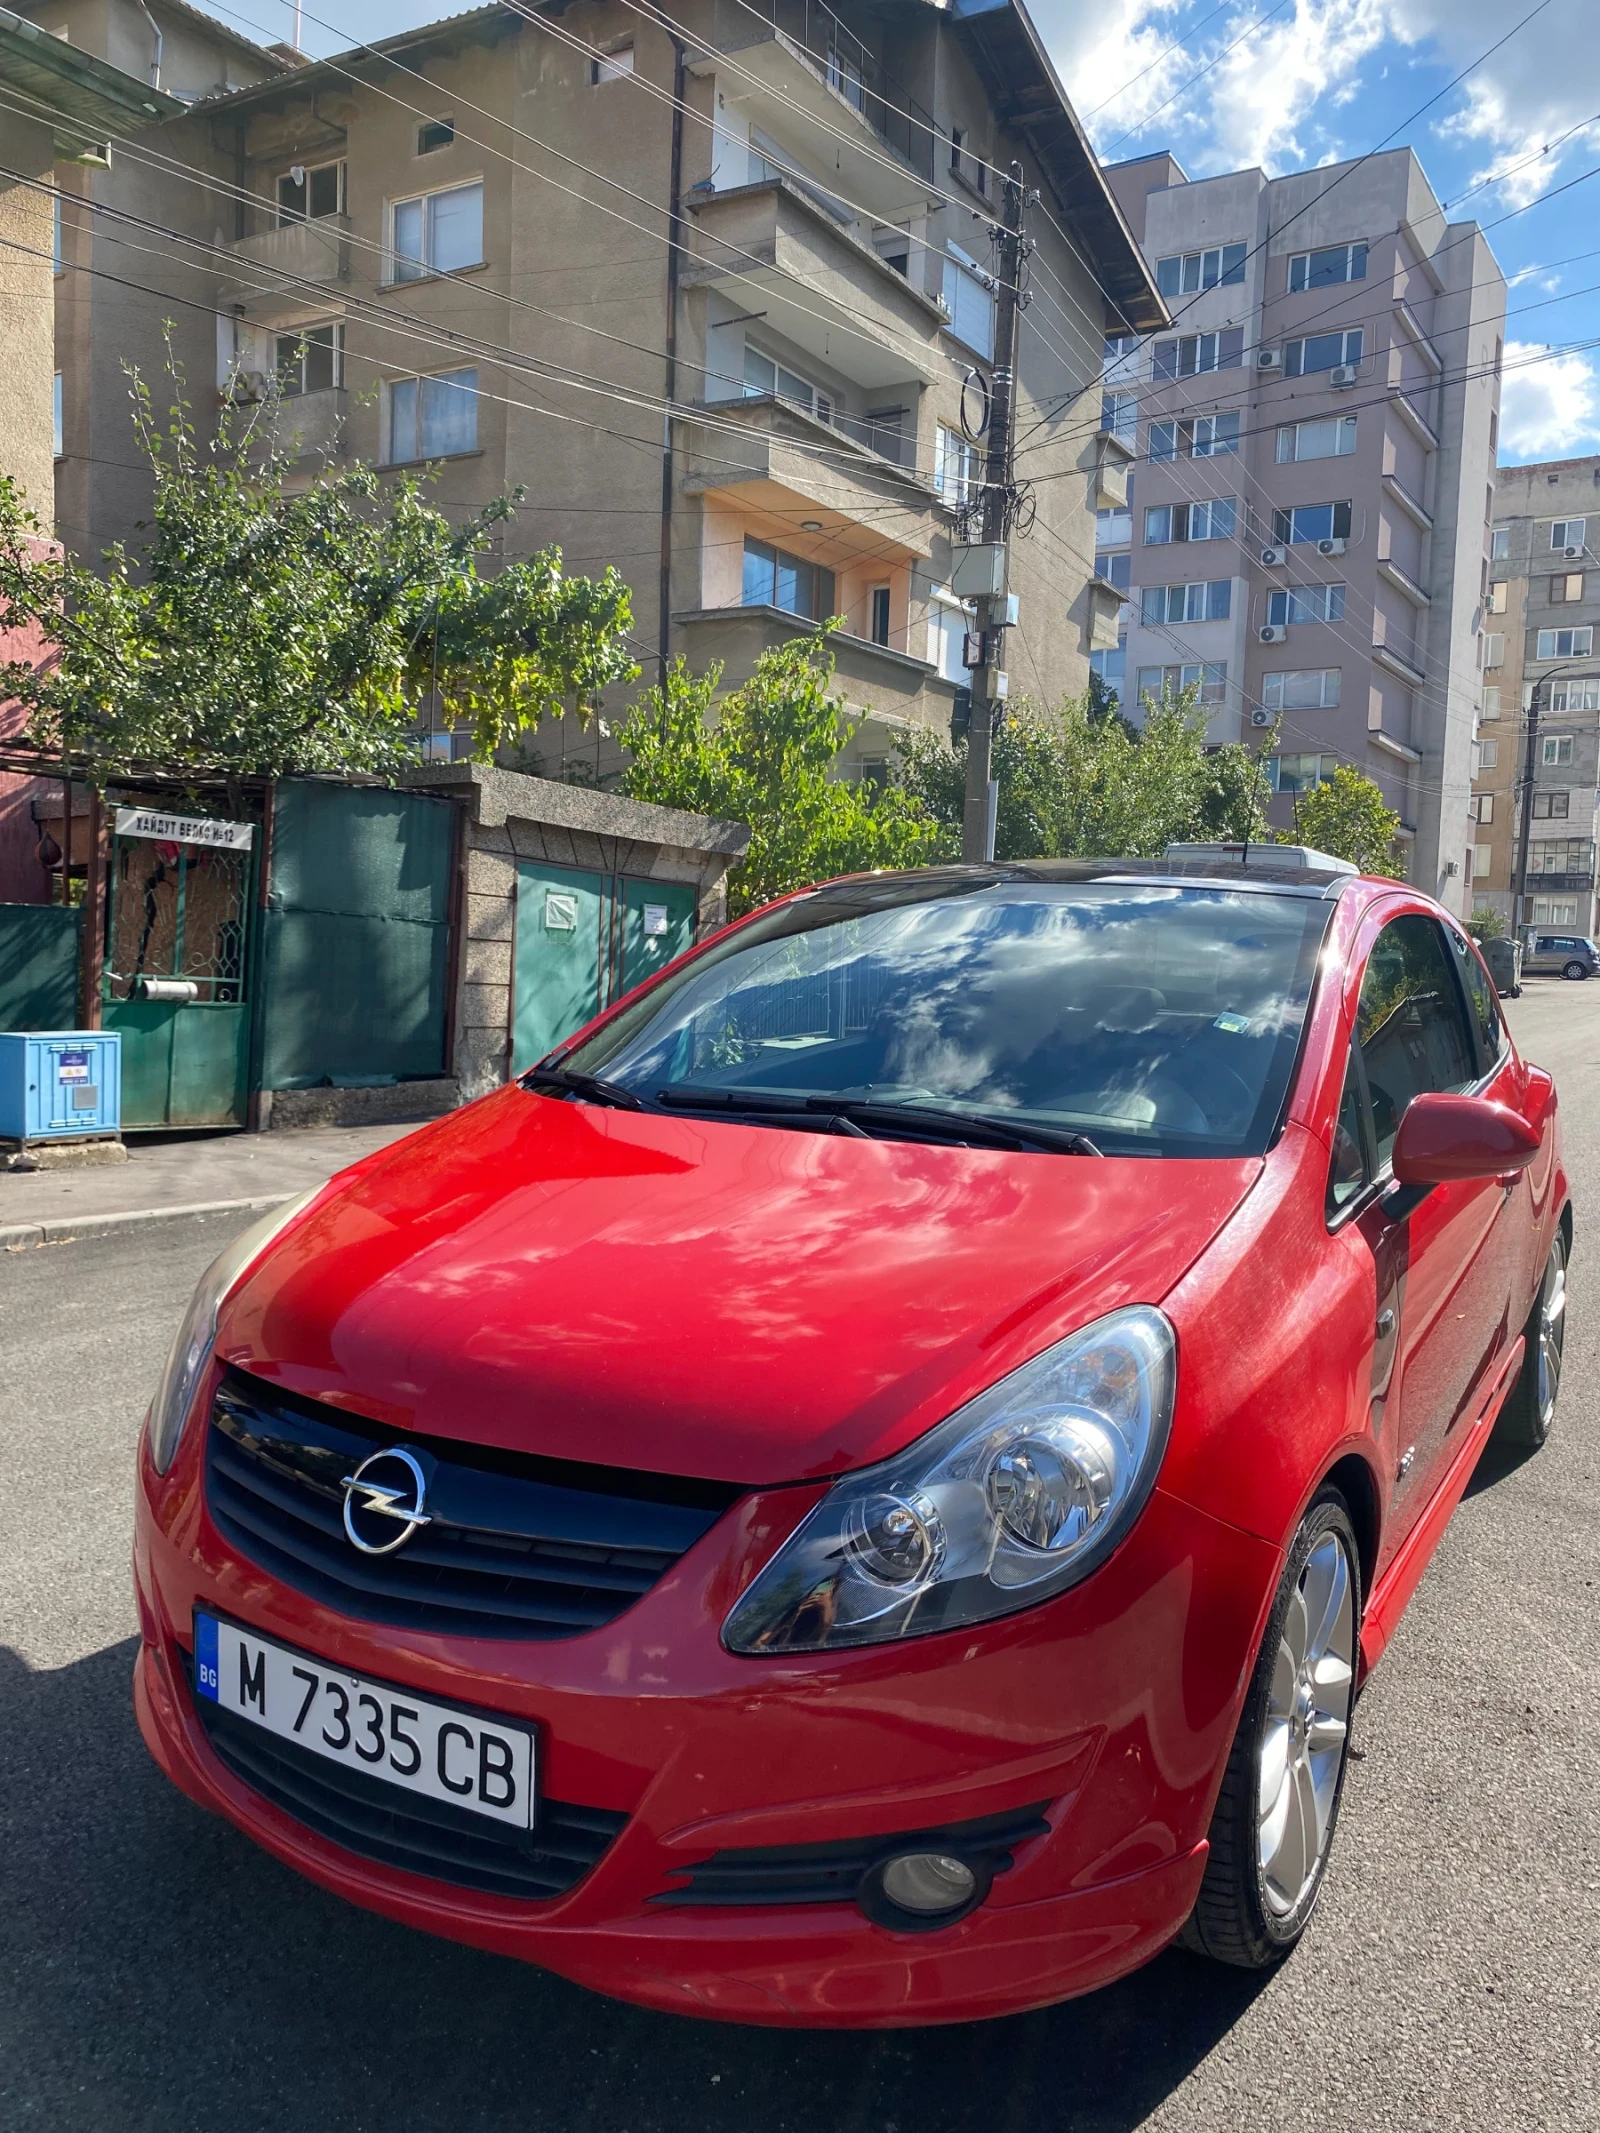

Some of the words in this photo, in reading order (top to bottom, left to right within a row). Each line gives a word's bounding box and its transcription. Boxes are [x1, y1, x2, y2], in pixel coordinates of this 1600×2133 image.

[136, 816, 176, 835] ХАЙДУТ
[179, 822, 211, 840] ВЕЛКО
[199, 1664, 217, 1688] BG
[240, 1642, 266, 1716] M
[292, 1666, 421, 1776] 7335
[437, 1722, 516, 1809] CB
